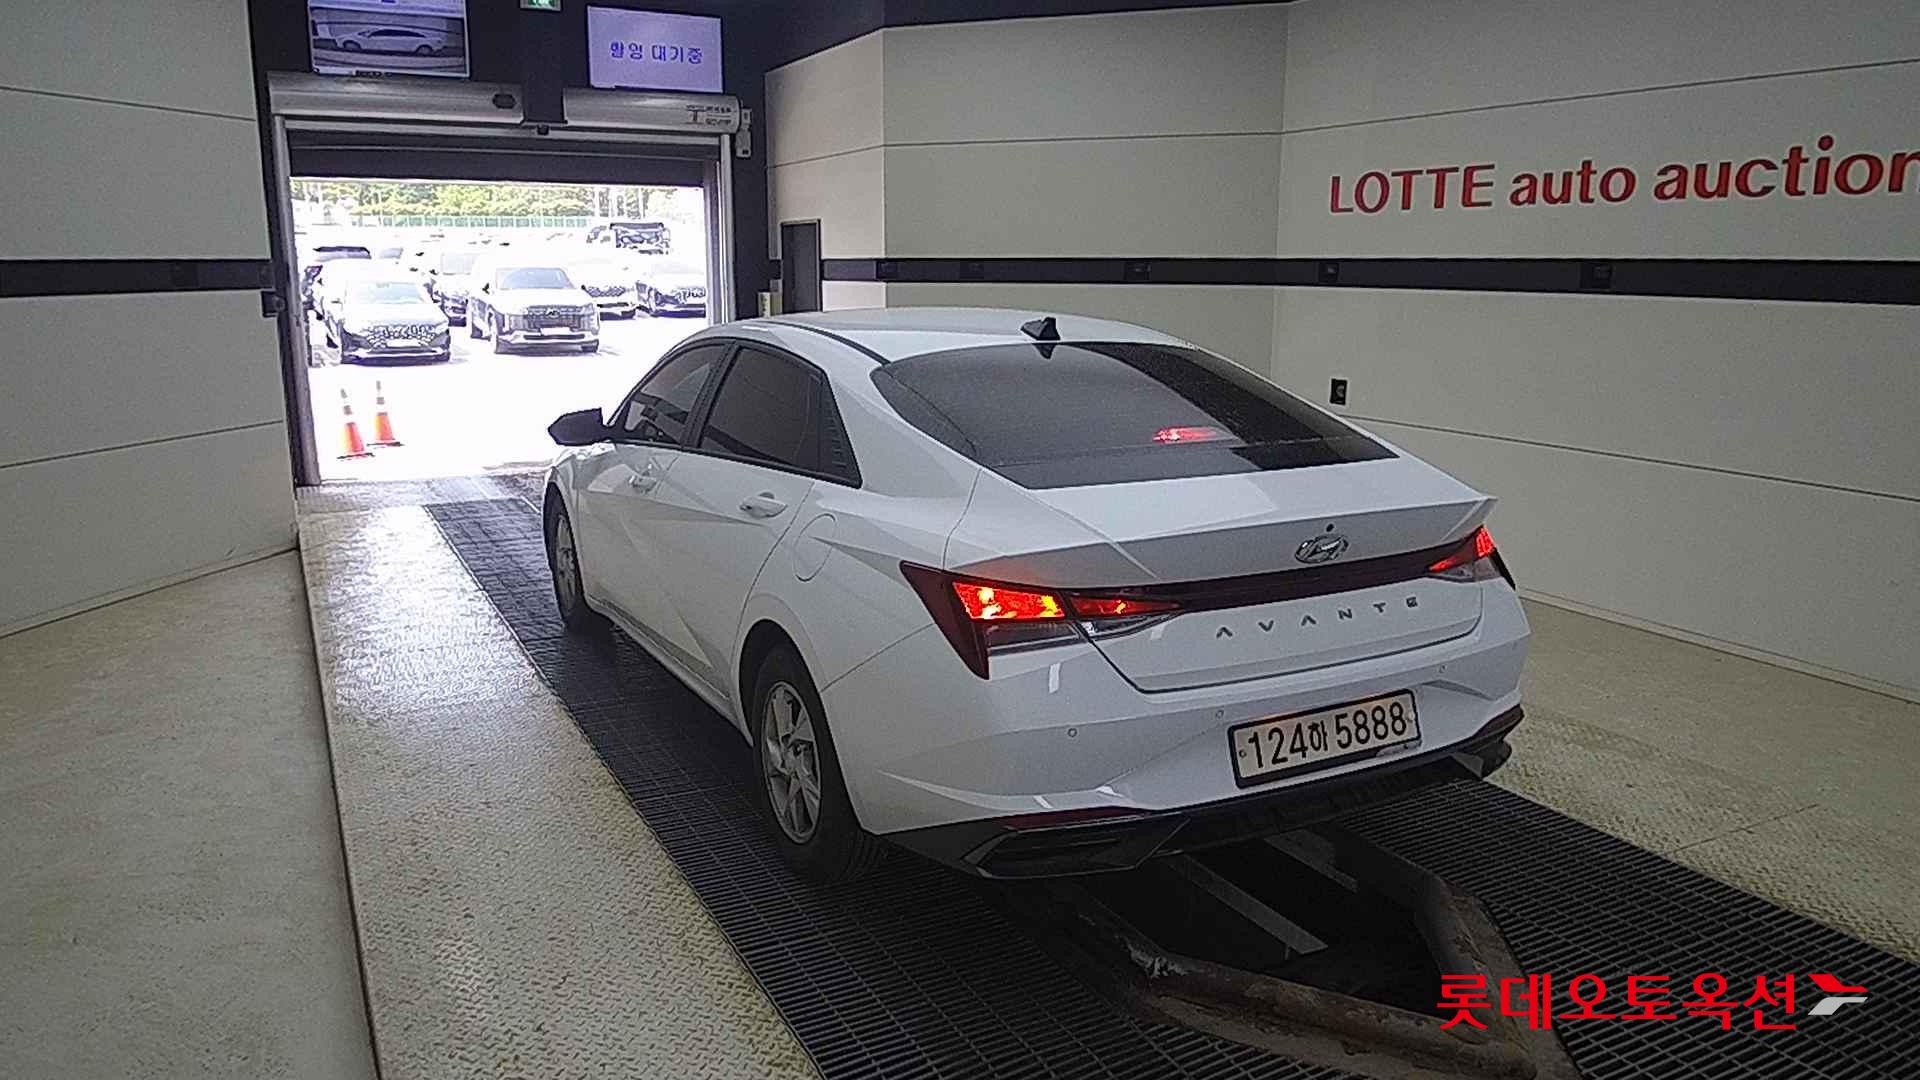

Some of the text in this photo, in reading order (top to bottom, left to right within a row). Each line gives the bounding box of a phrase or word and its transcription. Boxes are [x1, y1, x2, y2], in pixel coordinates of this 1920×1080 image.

[652, 45, 703, 64] 대기중
[1330, 163, 1496, 214] LOTTE
[1509, 159, 1636, 206] auto
[1216, 596, 1419, 639] AVANTE
[1248, 701, 1407, 768] 124하 5888
